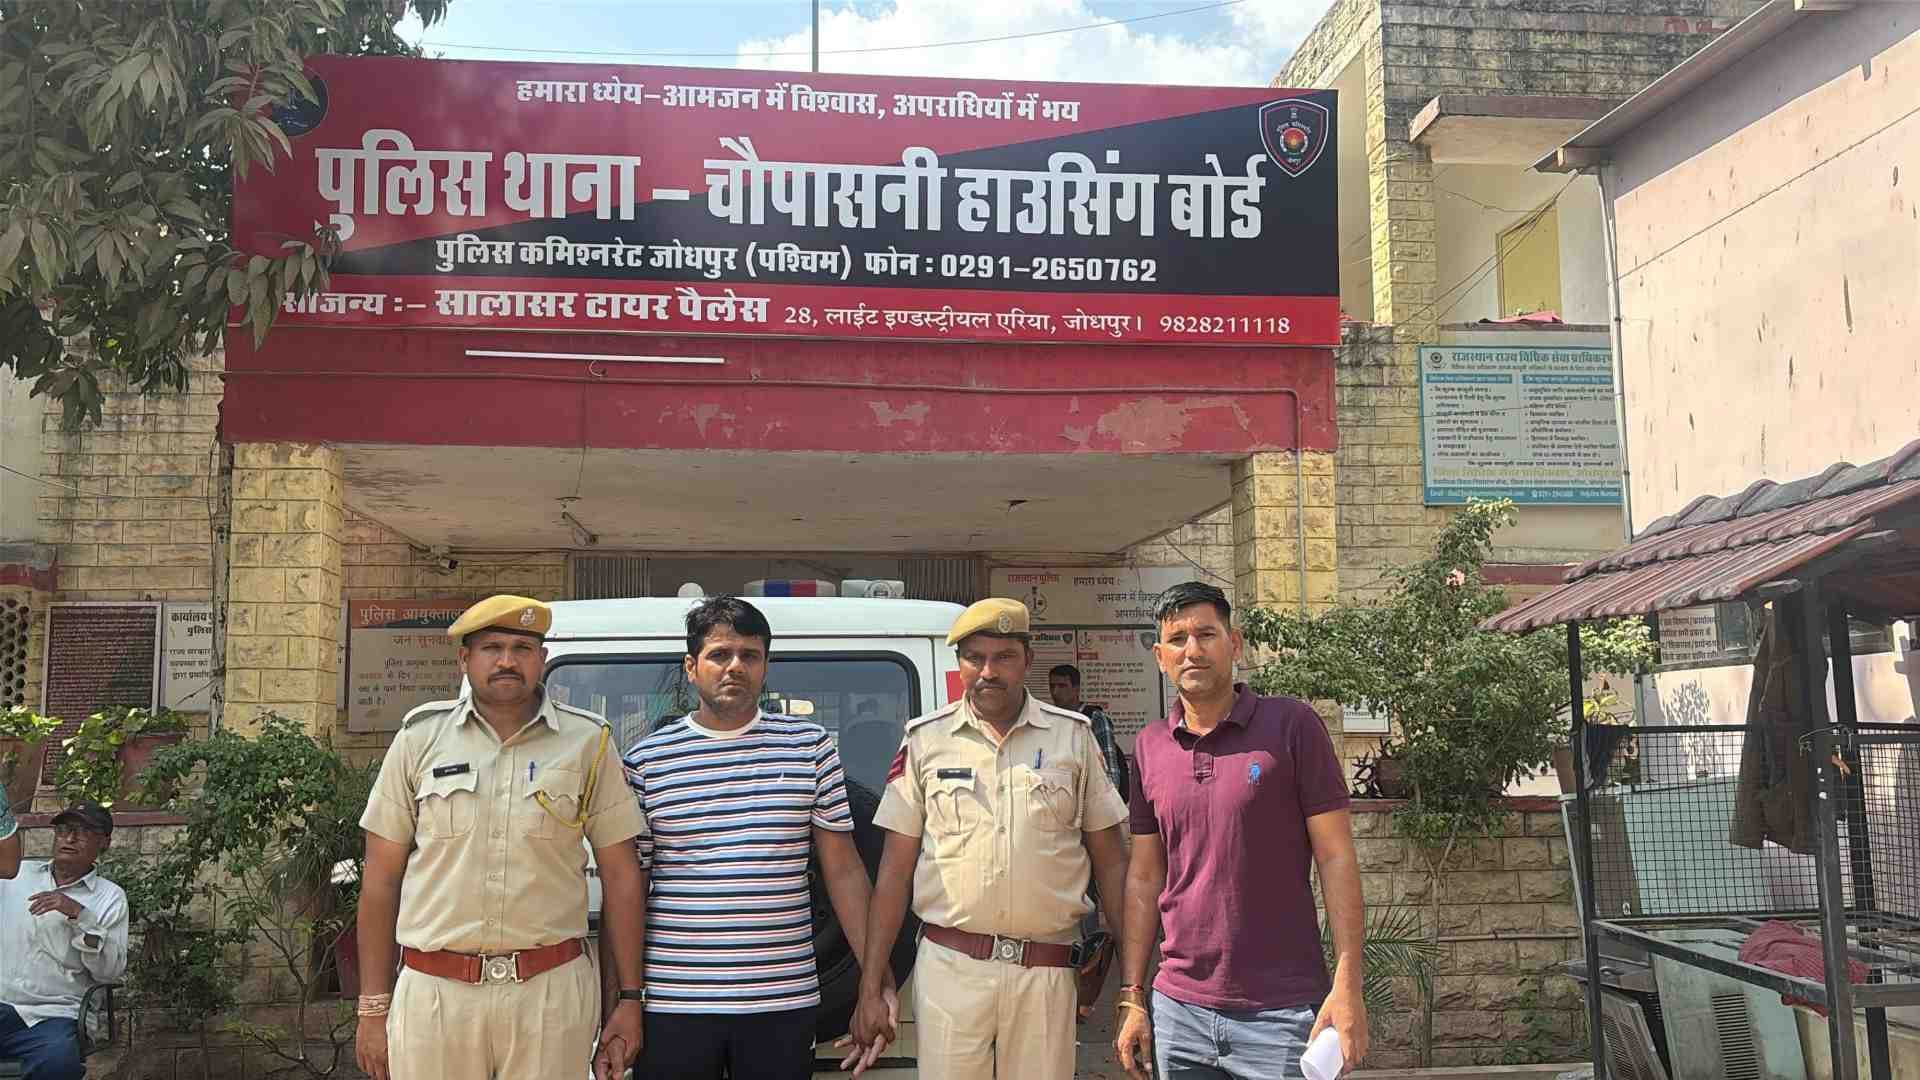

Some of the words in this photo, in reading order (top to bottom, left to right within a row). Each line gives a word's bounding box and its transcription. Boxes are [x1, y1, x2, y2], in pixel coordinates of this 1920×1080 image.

[516, 80, 588, 103] हमारा
[764, 82, 790, 111] में
[790, 84, 885, 119] विश्वास,
[893, 89, 1015, 121] अपराधियों
[1016, 93, 1041, 120] में
[1042, 101, 1081, 122] भय
[314, 129, 493, 240] पुलिस
[503, 151, 641, 221] थाना
[703, 136, 947, 231] चौपासनी
[954, 149, 1160, 237] हाउसिंग
[1167, 153, 1268, 239] बोर्ड
[436, 234, 513, 272] पुलिस
[519, 236, 644, 267] कमिश्नरेट
[648, 238, 738, 278] जोधपुर
[745, 242, 852, 281] (पश्चिम)
[284, 287, 387, 315] सजन्य
[435, 290, 577, 318] सालासर
[584, 294, 670, 320] टायर
[676, 287, 771, 323] पैलेस
[784, 307, 818, 328] 28,
[824, 303, 879, 329] लाईट
[884, 306, 990, 337] इण्डस्ट्रीयल
[996, 306, 1057, 335] एरिया,
[1159, 316, 1291, 335] 9828211118
[171, 609, 208, 623] कार्यालय
[187, 624, 212, 637] पुलिस
[359, 604, 396, 625] पुलिस
